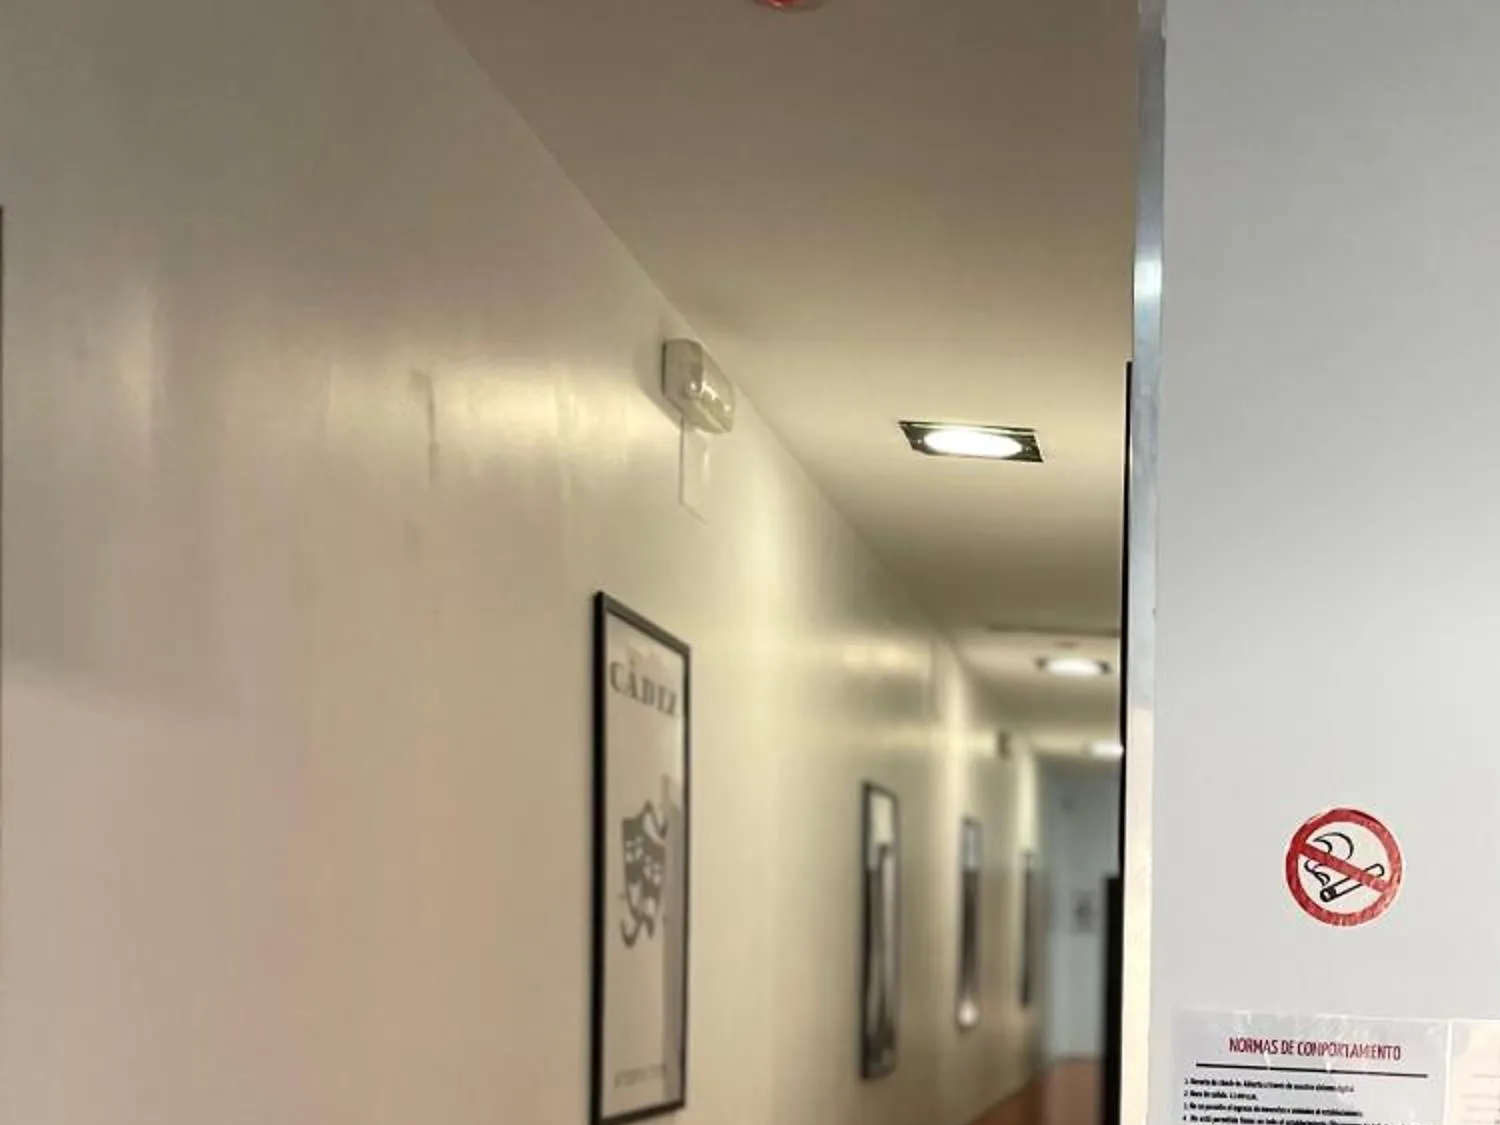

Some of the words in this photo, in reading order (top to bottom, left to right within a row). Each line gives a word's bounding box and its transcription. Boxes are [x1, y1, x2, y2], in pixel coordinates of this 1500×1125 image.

[1229, 1037, 1279, 1055] NORMAS
[1281, 1039, 1294, 1055] DE
[1297, 1041, 1401, 1061] COMPORTAMIENTO
